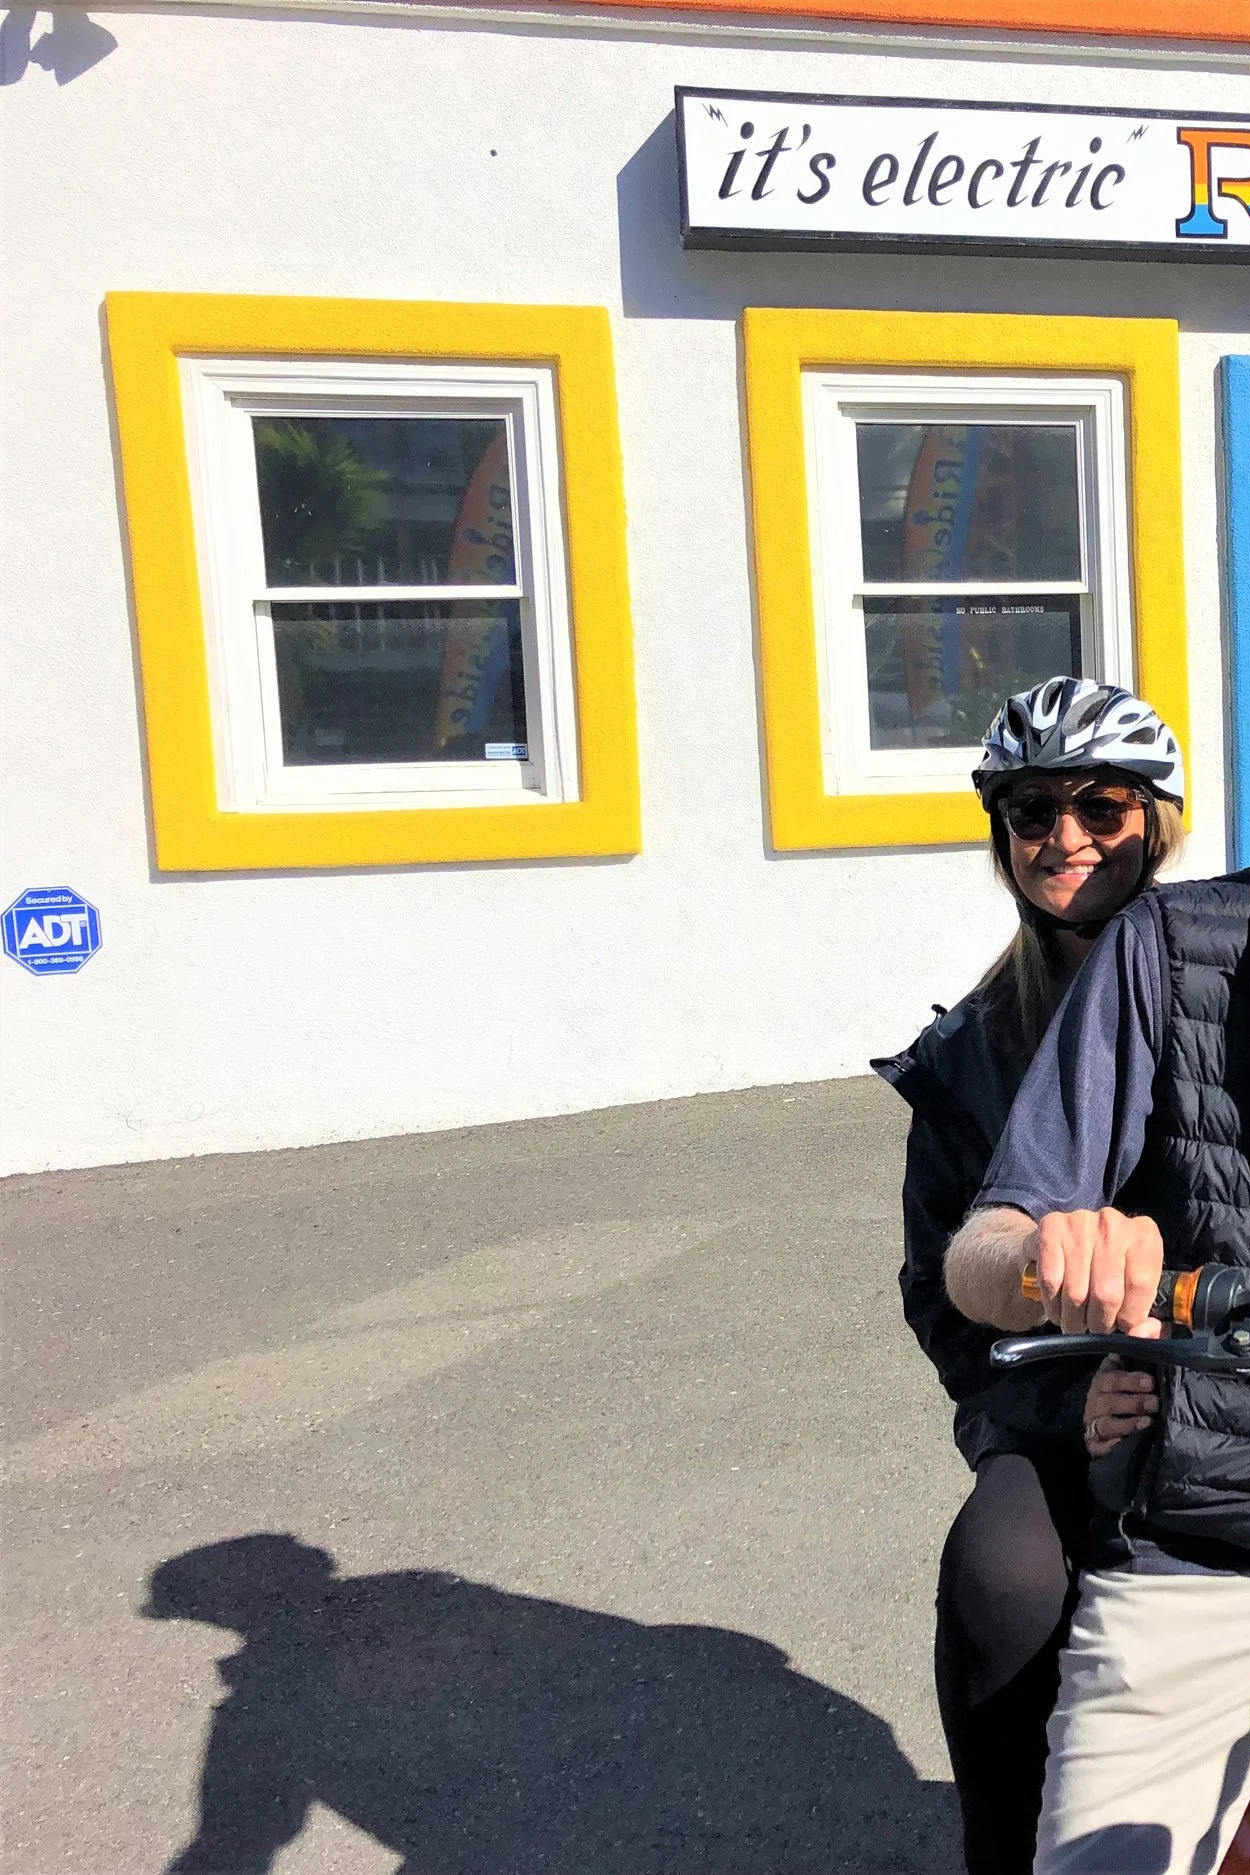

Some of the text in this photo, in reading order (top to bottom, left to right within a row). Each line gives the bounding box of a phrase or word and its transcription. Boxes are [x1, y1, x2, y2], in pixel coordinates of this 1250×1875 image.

[717, 121, 837, 205] it's
[862, 130, 1126, 210] electric
[956, 605, 1045, 615] NO PUBLIC BATHROOMS
[25, 895, 73, 904] Secured by
[19, 913, 87, 950] ADT
